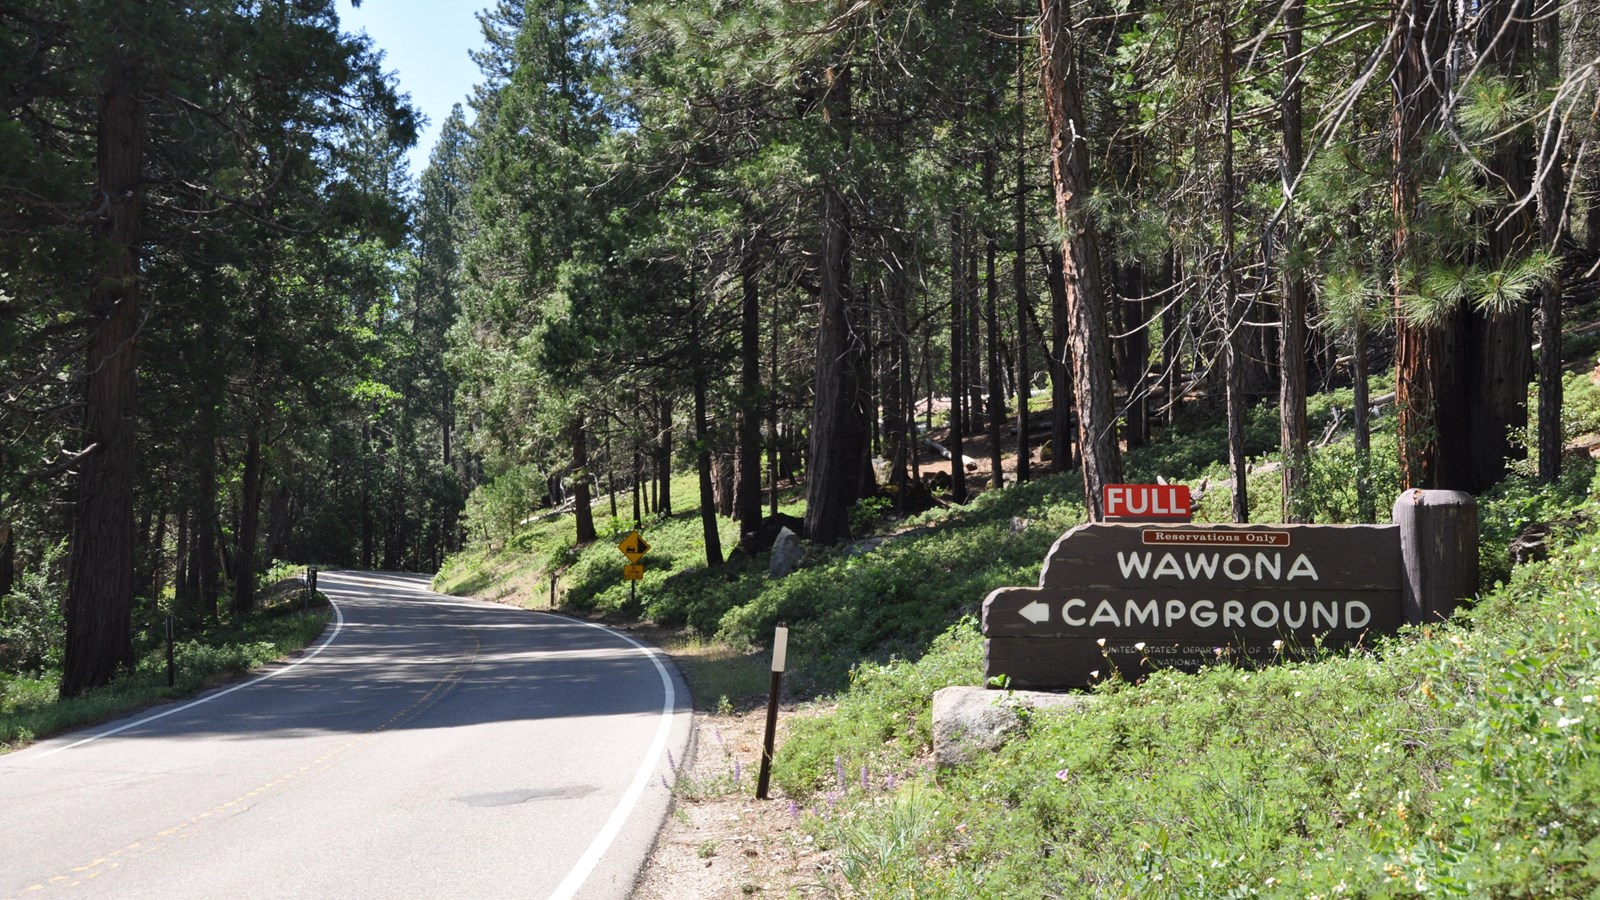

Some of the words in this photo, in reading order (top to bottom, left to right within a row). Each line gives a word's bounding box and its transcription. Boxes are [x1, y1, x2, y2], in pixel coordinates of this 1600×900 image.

[1107, 487, 1187, 515] FULL
[1154, 532, 1241, 542] Reservations
[1245, 533, 1277, 544] Only
[1116, 551, 1319, 581] WAWONA
[1061, 598, 1372, 629] CAMPGROUND
[1106, 646, 1138, 654] UNITED
[1143, 646, 1178, 654] STATES
[1182, 646, 1242, 655] DEPARTNT
[1247, 646, 1261, 654] OF
[1157, 658, 1201, 666] NATIONAL
